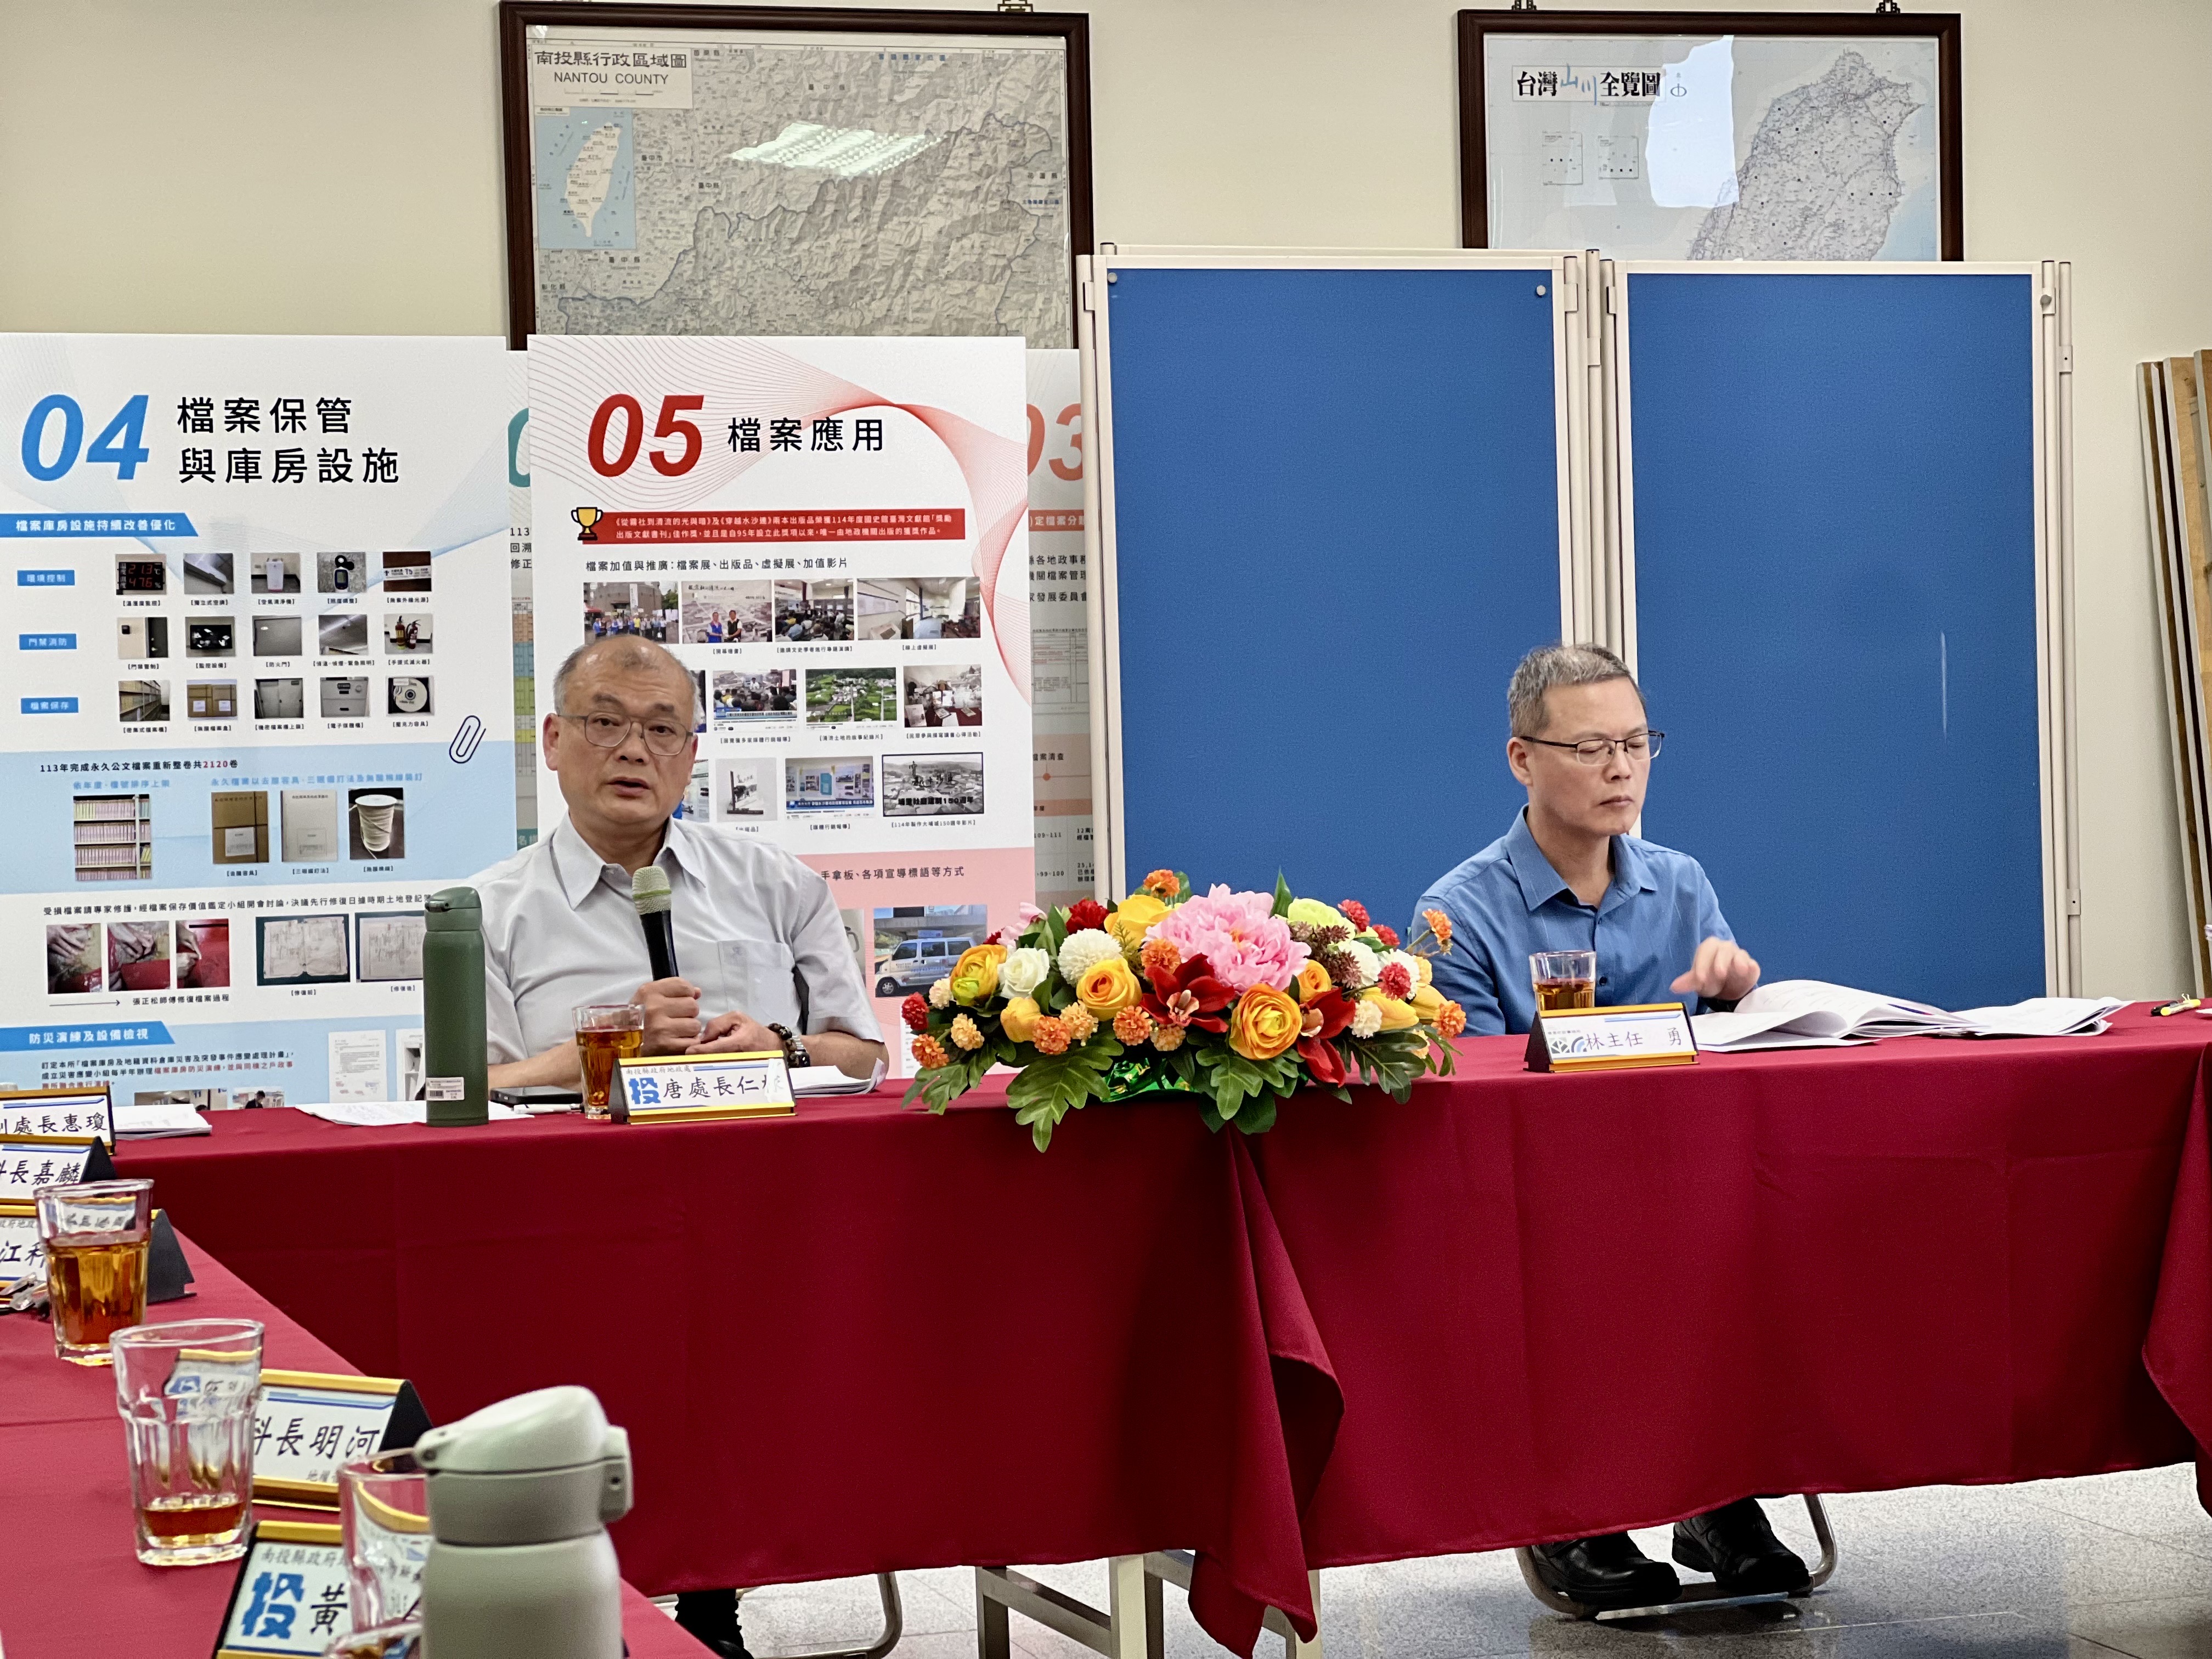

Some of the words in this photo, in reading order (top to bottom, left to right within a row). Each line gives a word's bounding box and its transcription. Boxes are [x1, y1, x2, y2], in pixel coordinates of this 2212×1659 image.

[534, 50, 687, 68] 南投縣行政區域圖
[554, 72, 608, 83] NANTOU
[615, 73, 669, 84] COUNTY
[1516, 63, 1661, 105] 台灣山川全覽圖
[176, 397, 353, 434] 檔案保管
[21, 393, 150, 482] 04
[587, 393, 704, 477] 05
[727, 417, 885, 453] 檔案應用
[178, 447, 400, 484] 與庫房設施
[16, 519, 176, 532] 檔案庫房設施持續改善優化
[510, 527, 530, 536] 113
[511, 558, 532, 569] 修正
[29, 1028, 149, 1045] 防災演練及設備檢視
[1585, 1031, 1643, 1051] 林主任
[1667, 1027, 1681, 1046] 勇
[629, 1077, 661, 1104] 投
[0, 1159, 81, 1184] 長嘉麟
[241, 1572, 305, 1639] 投
[310, 1583, 348, 1635] 黃
